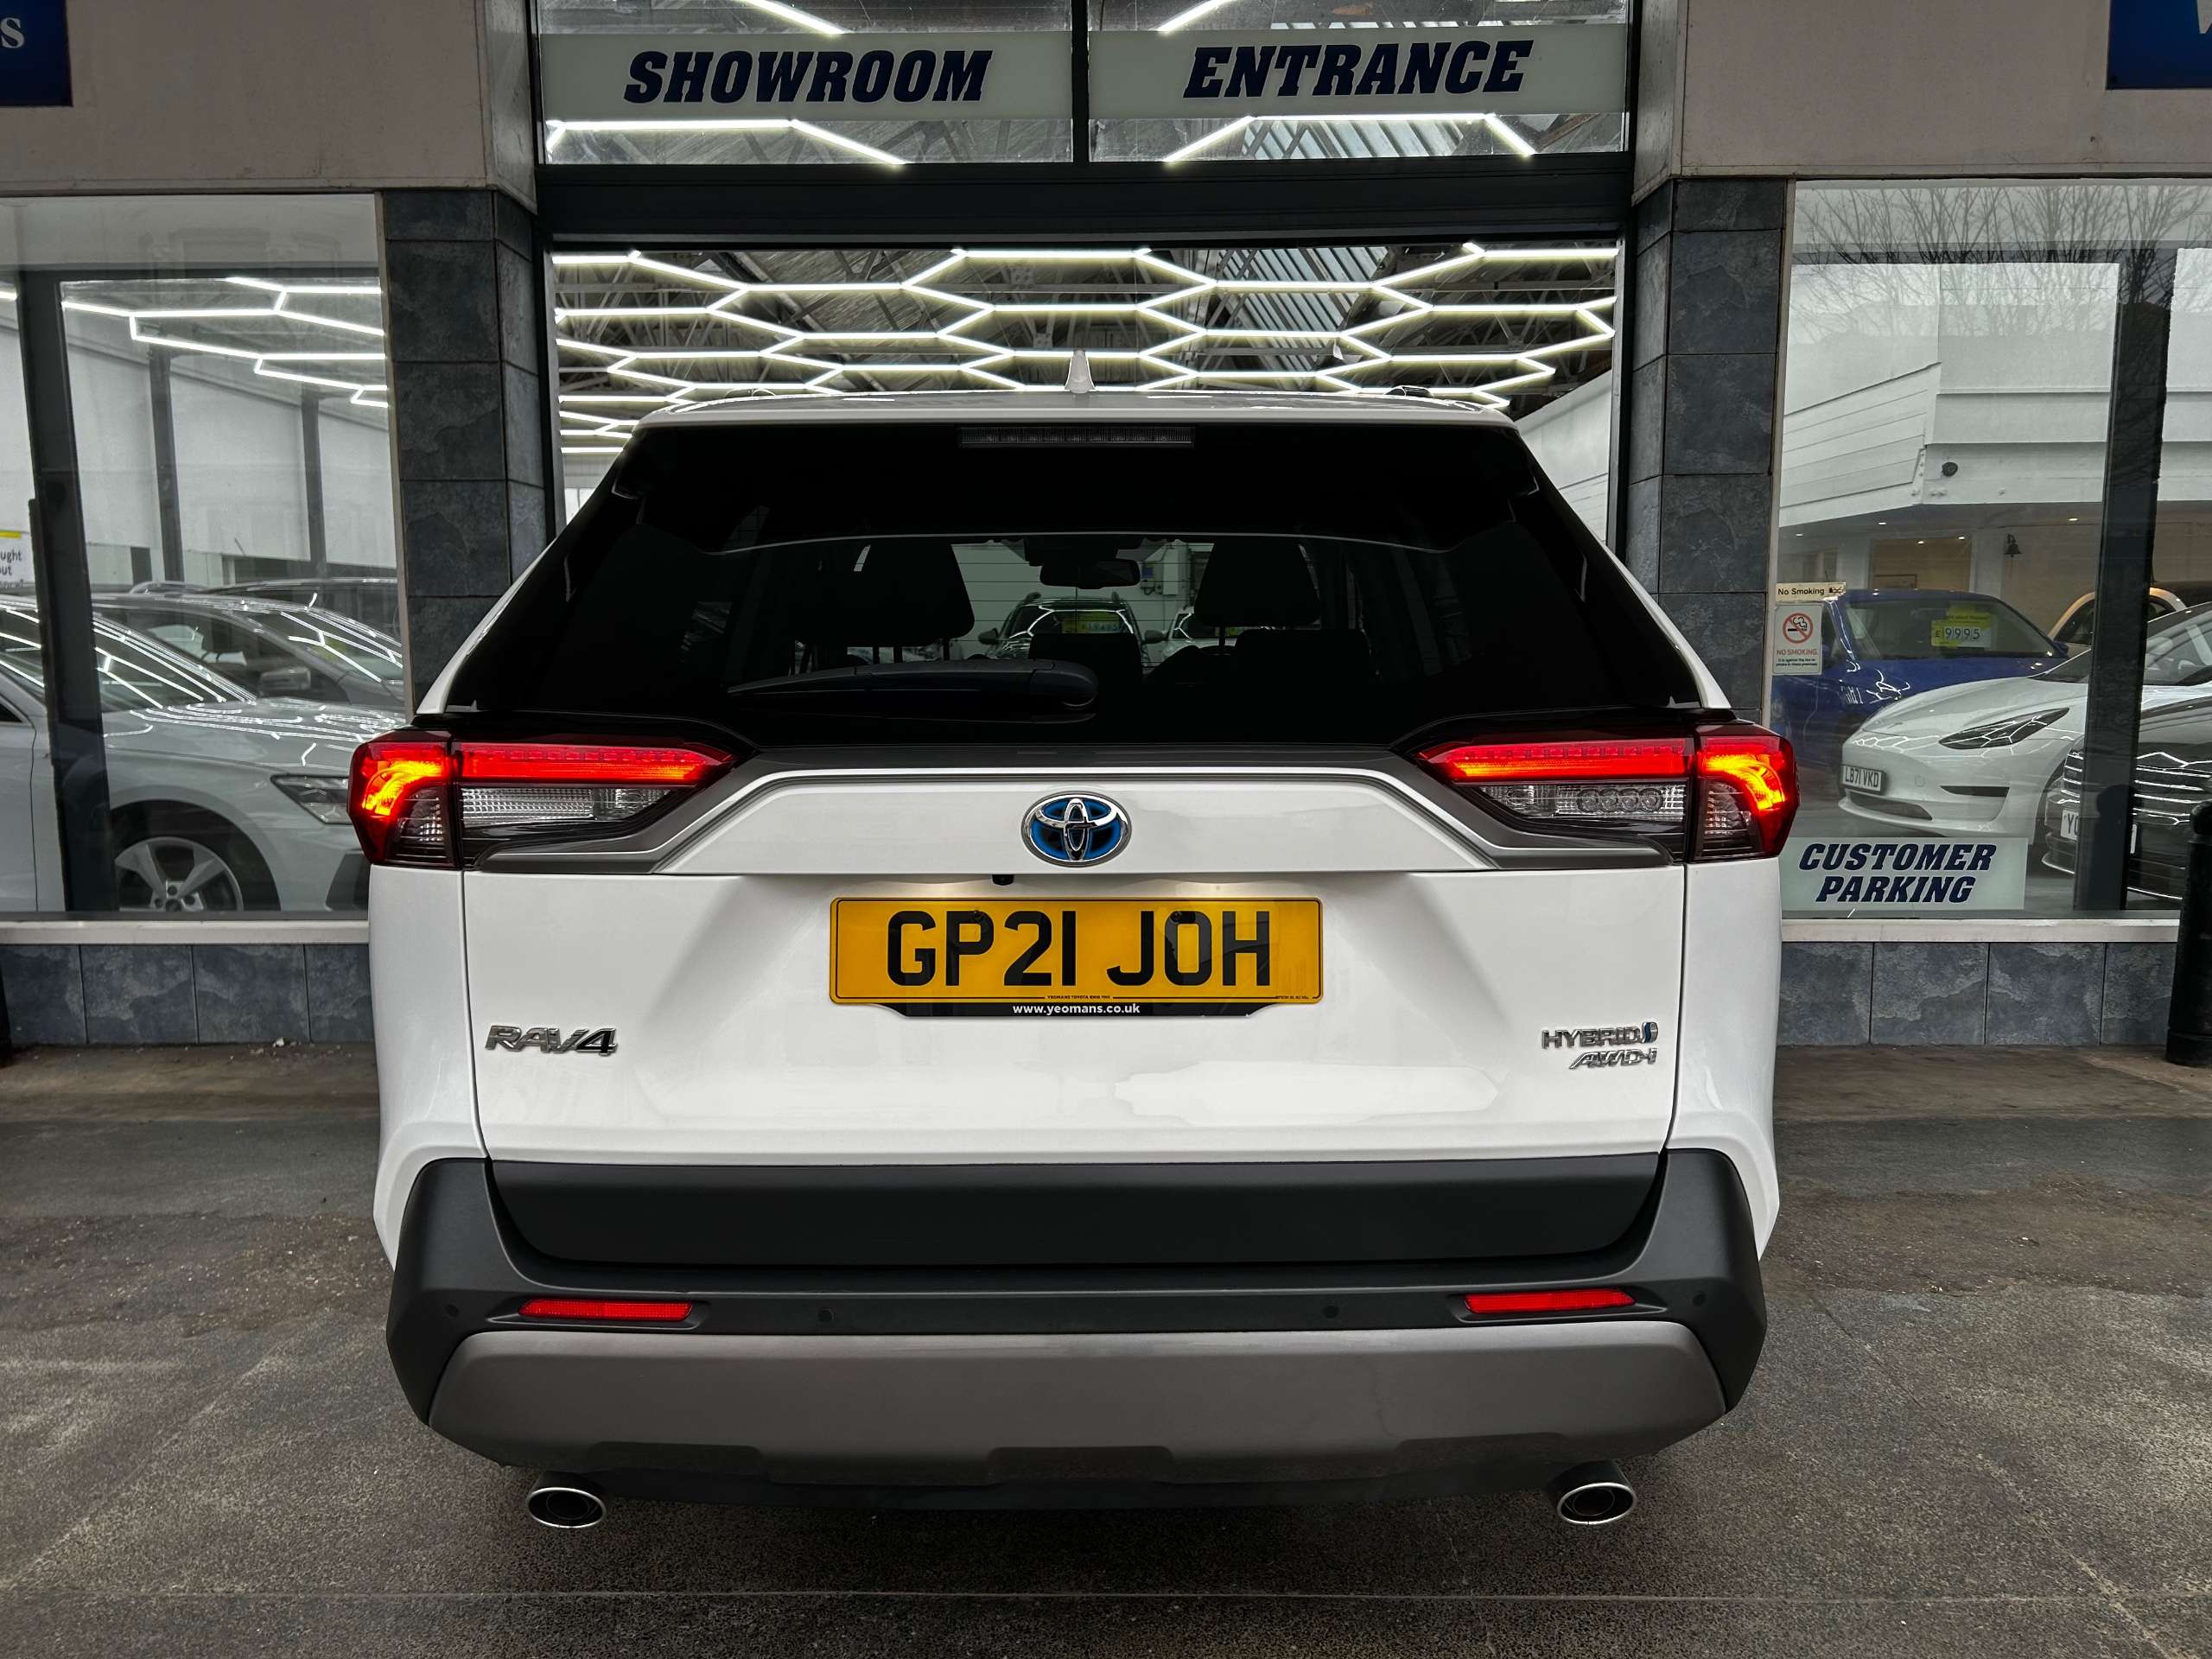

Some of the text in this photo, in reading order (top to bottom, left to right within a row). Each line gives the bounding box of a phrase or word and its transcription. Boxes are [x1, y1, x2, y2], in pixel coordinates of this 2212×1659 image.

[623, 49, 994, 104] SHOWROOM
[1182, 40, 1534, 99] ENTRANCE
[1791, 588, 1825, 596] Smoking
[1863, 769, 1879, 788] VKD
[1798, 843, 1997, 871] CUSTOMER
[1815, 875, 1976, 904] PARKING
[887, 910, 1271, 987] GP21 JOH
[1013, 1003, 1141, 1016] www.yeomans.co.uk
[485, 1025, 618, 1057] RAV4
[1541, 1026, 1642, 1049] HYBRID
